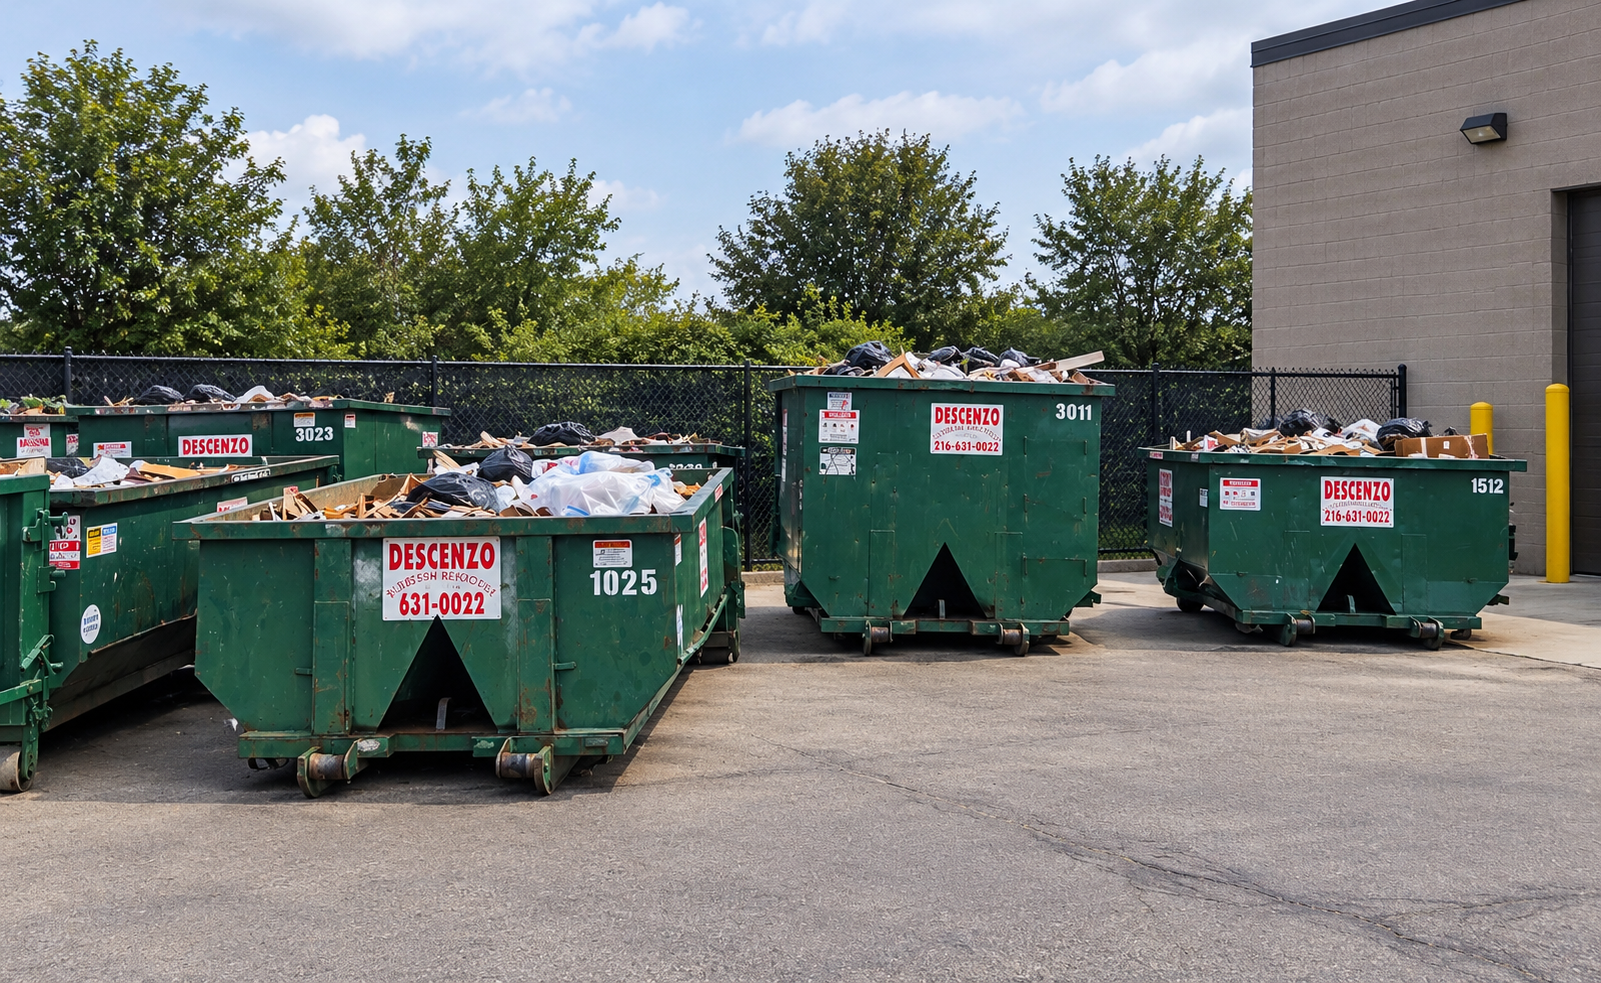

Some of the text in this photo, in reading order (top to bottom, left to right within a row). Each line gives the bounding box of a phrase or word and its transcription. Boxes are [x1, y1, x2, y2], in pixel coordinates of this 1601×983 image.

[934, 406, 1000, 427] DESCENZO
[1055, 403, 1092, 421] 3011
[295, 426, 334, 442] 3023
[182, 437, 249, 456] DESCENZO
[934, 440, 999, 453] 216-631-0022
[1324, 480, 1391, 502] DESCENZO
[1471, 477, 1504, 494] 1512
[1324, 509, 1390, 524] 216-631-0022
[388, 542, 496, 571] DESCENZO
[589, 569, 658, 596] 1025
[399, 592, 485, 616] 631-0022
